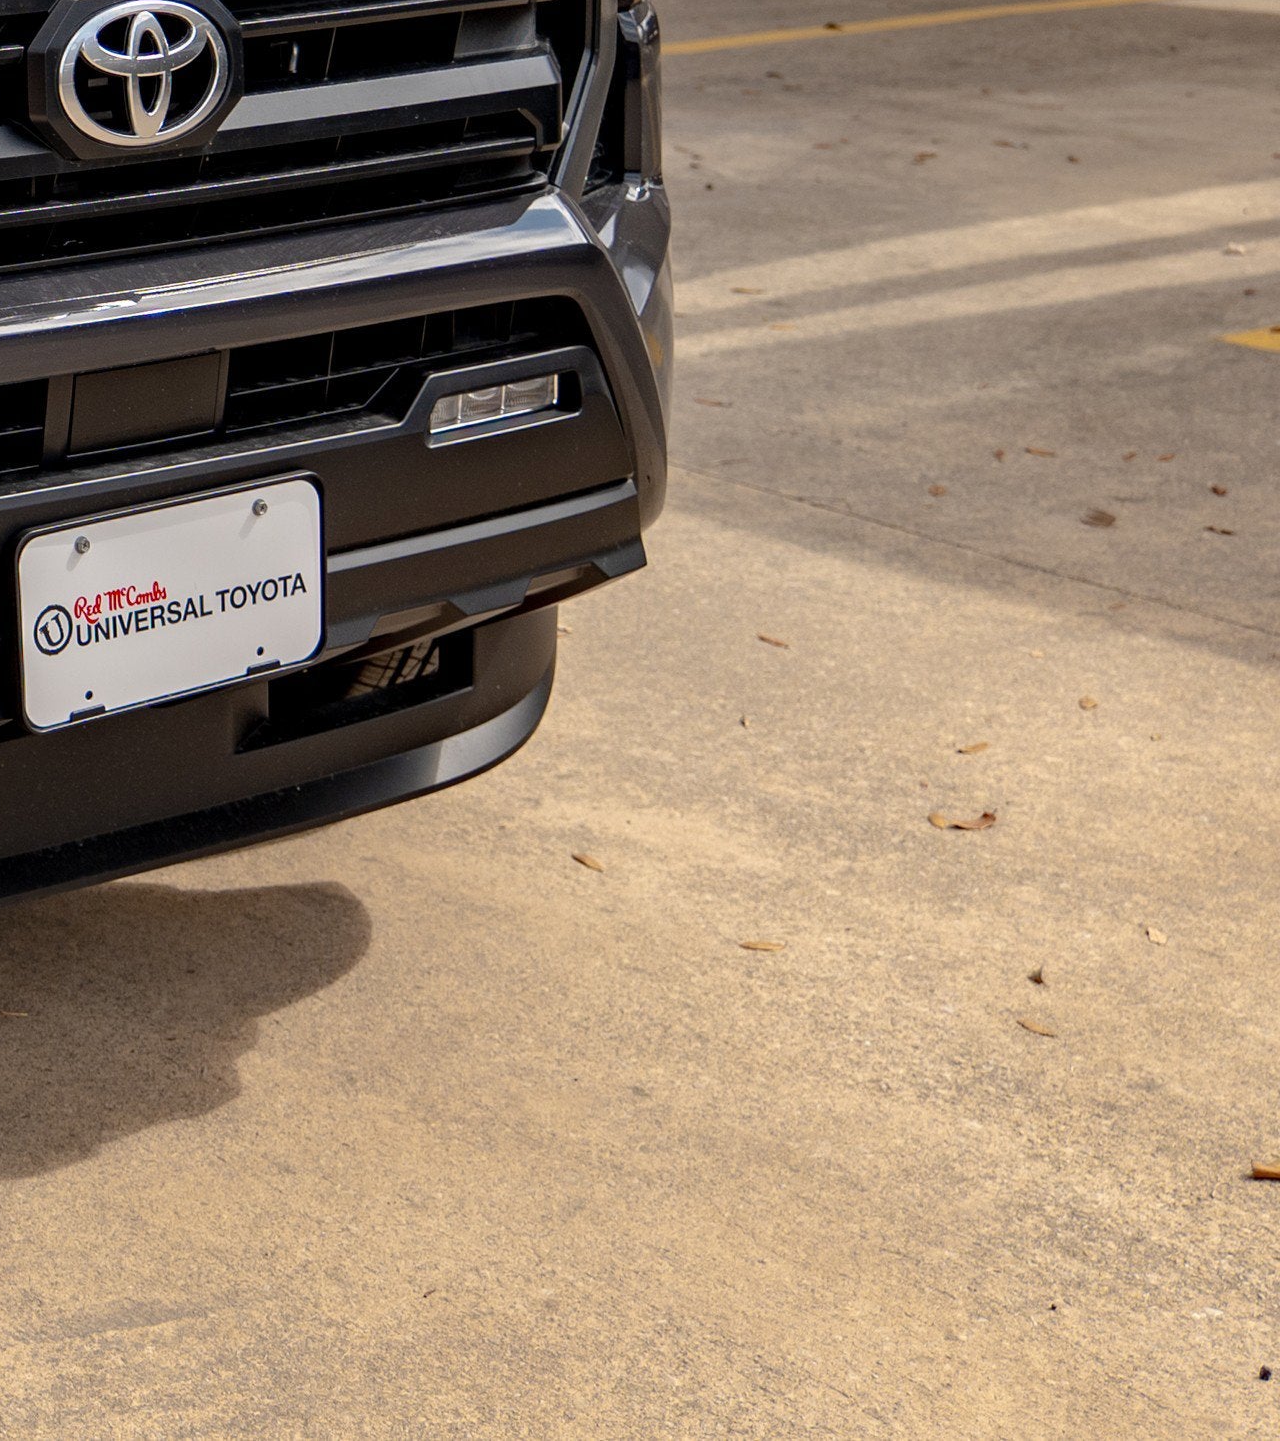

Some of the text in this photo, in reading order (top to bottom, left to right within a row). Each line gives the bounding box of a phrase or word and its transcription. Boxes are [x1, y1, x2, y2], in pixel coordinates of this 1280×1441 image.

[74, 581, 167, 625] Red McCombs
[76, 572, 307, 647] UNIVERSAL TOYOTA
